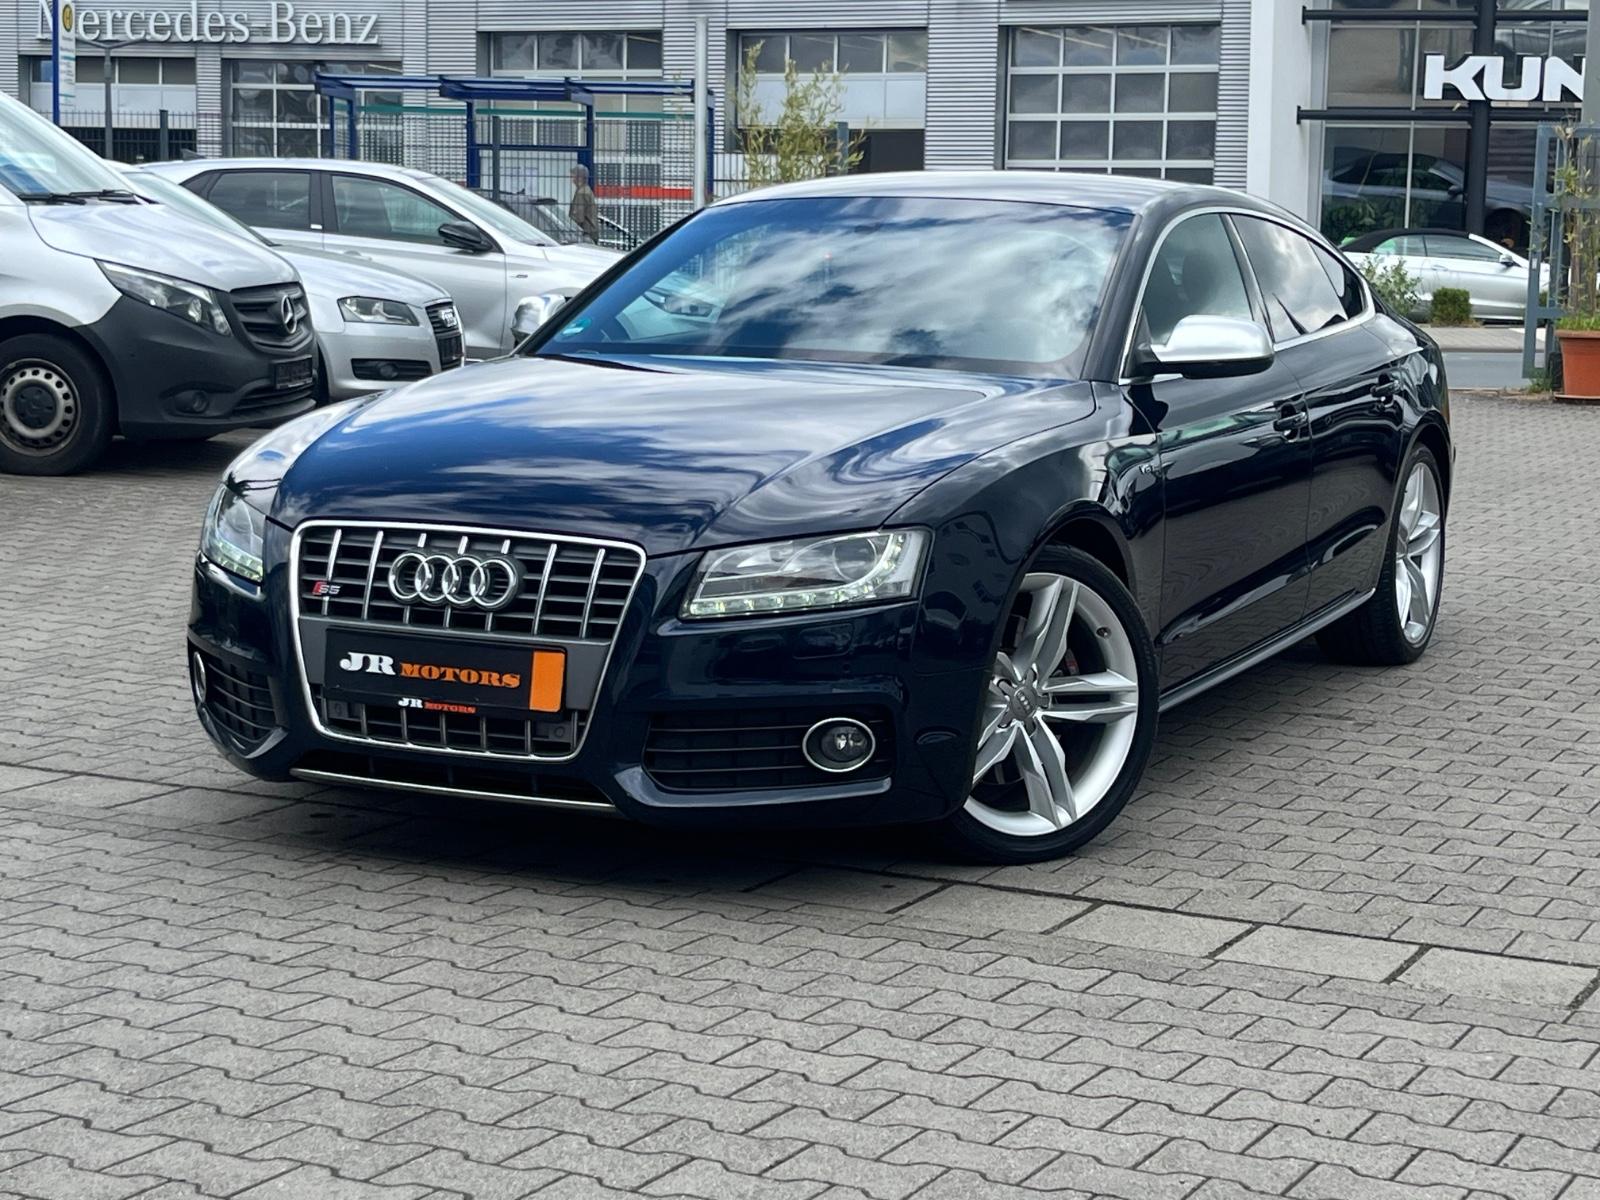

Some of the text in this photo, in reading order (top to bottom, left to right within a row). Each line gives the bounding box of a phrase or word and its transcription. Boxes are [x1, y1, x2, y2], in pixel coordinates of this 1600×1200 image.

[340, 652, 521, 689] JR MOTORS
[398, 698, 477, 714] JR MOTORS
